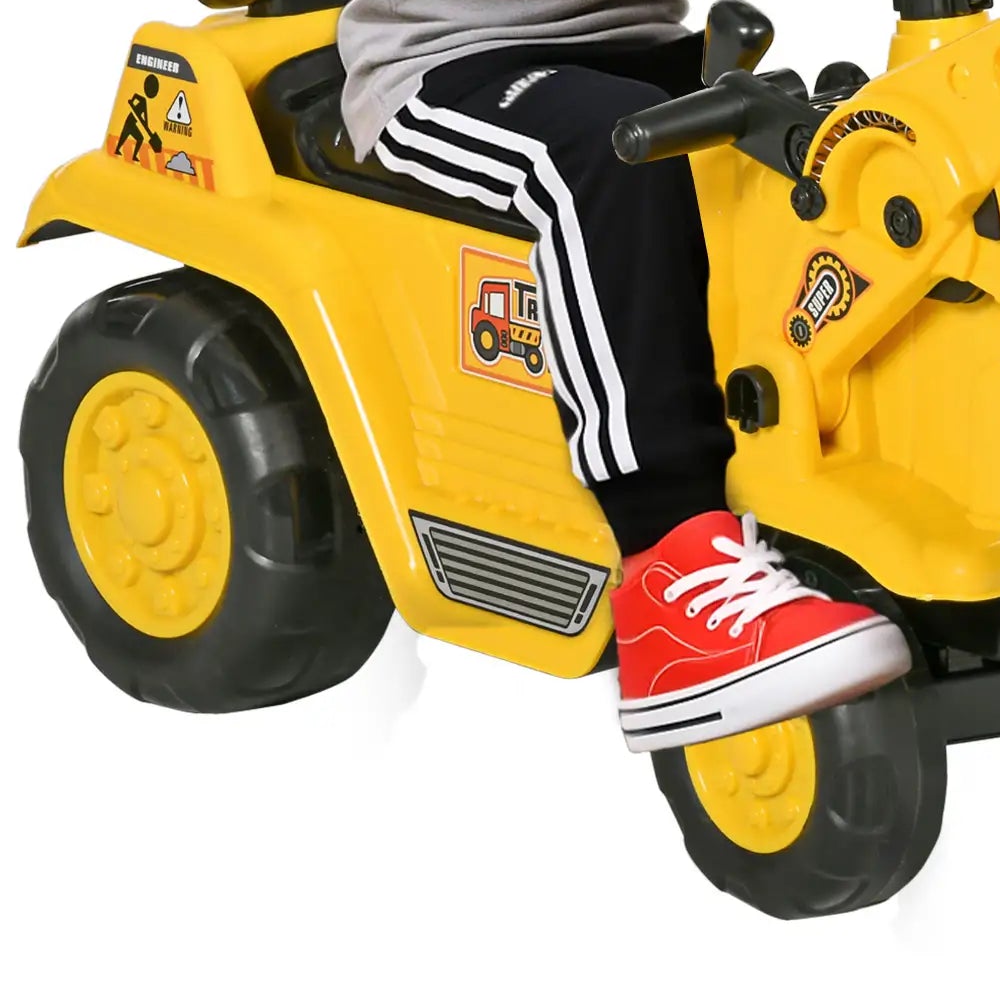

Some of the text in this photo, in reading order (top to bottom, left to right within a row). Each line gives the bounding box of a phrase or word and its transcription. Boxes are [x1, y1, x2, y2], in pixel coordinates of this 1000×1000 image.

[135, 53, 180, 74] ENGINEER
[163, 121, 193, 138] WARNING
[807, 279, 835, 318] SUPER
